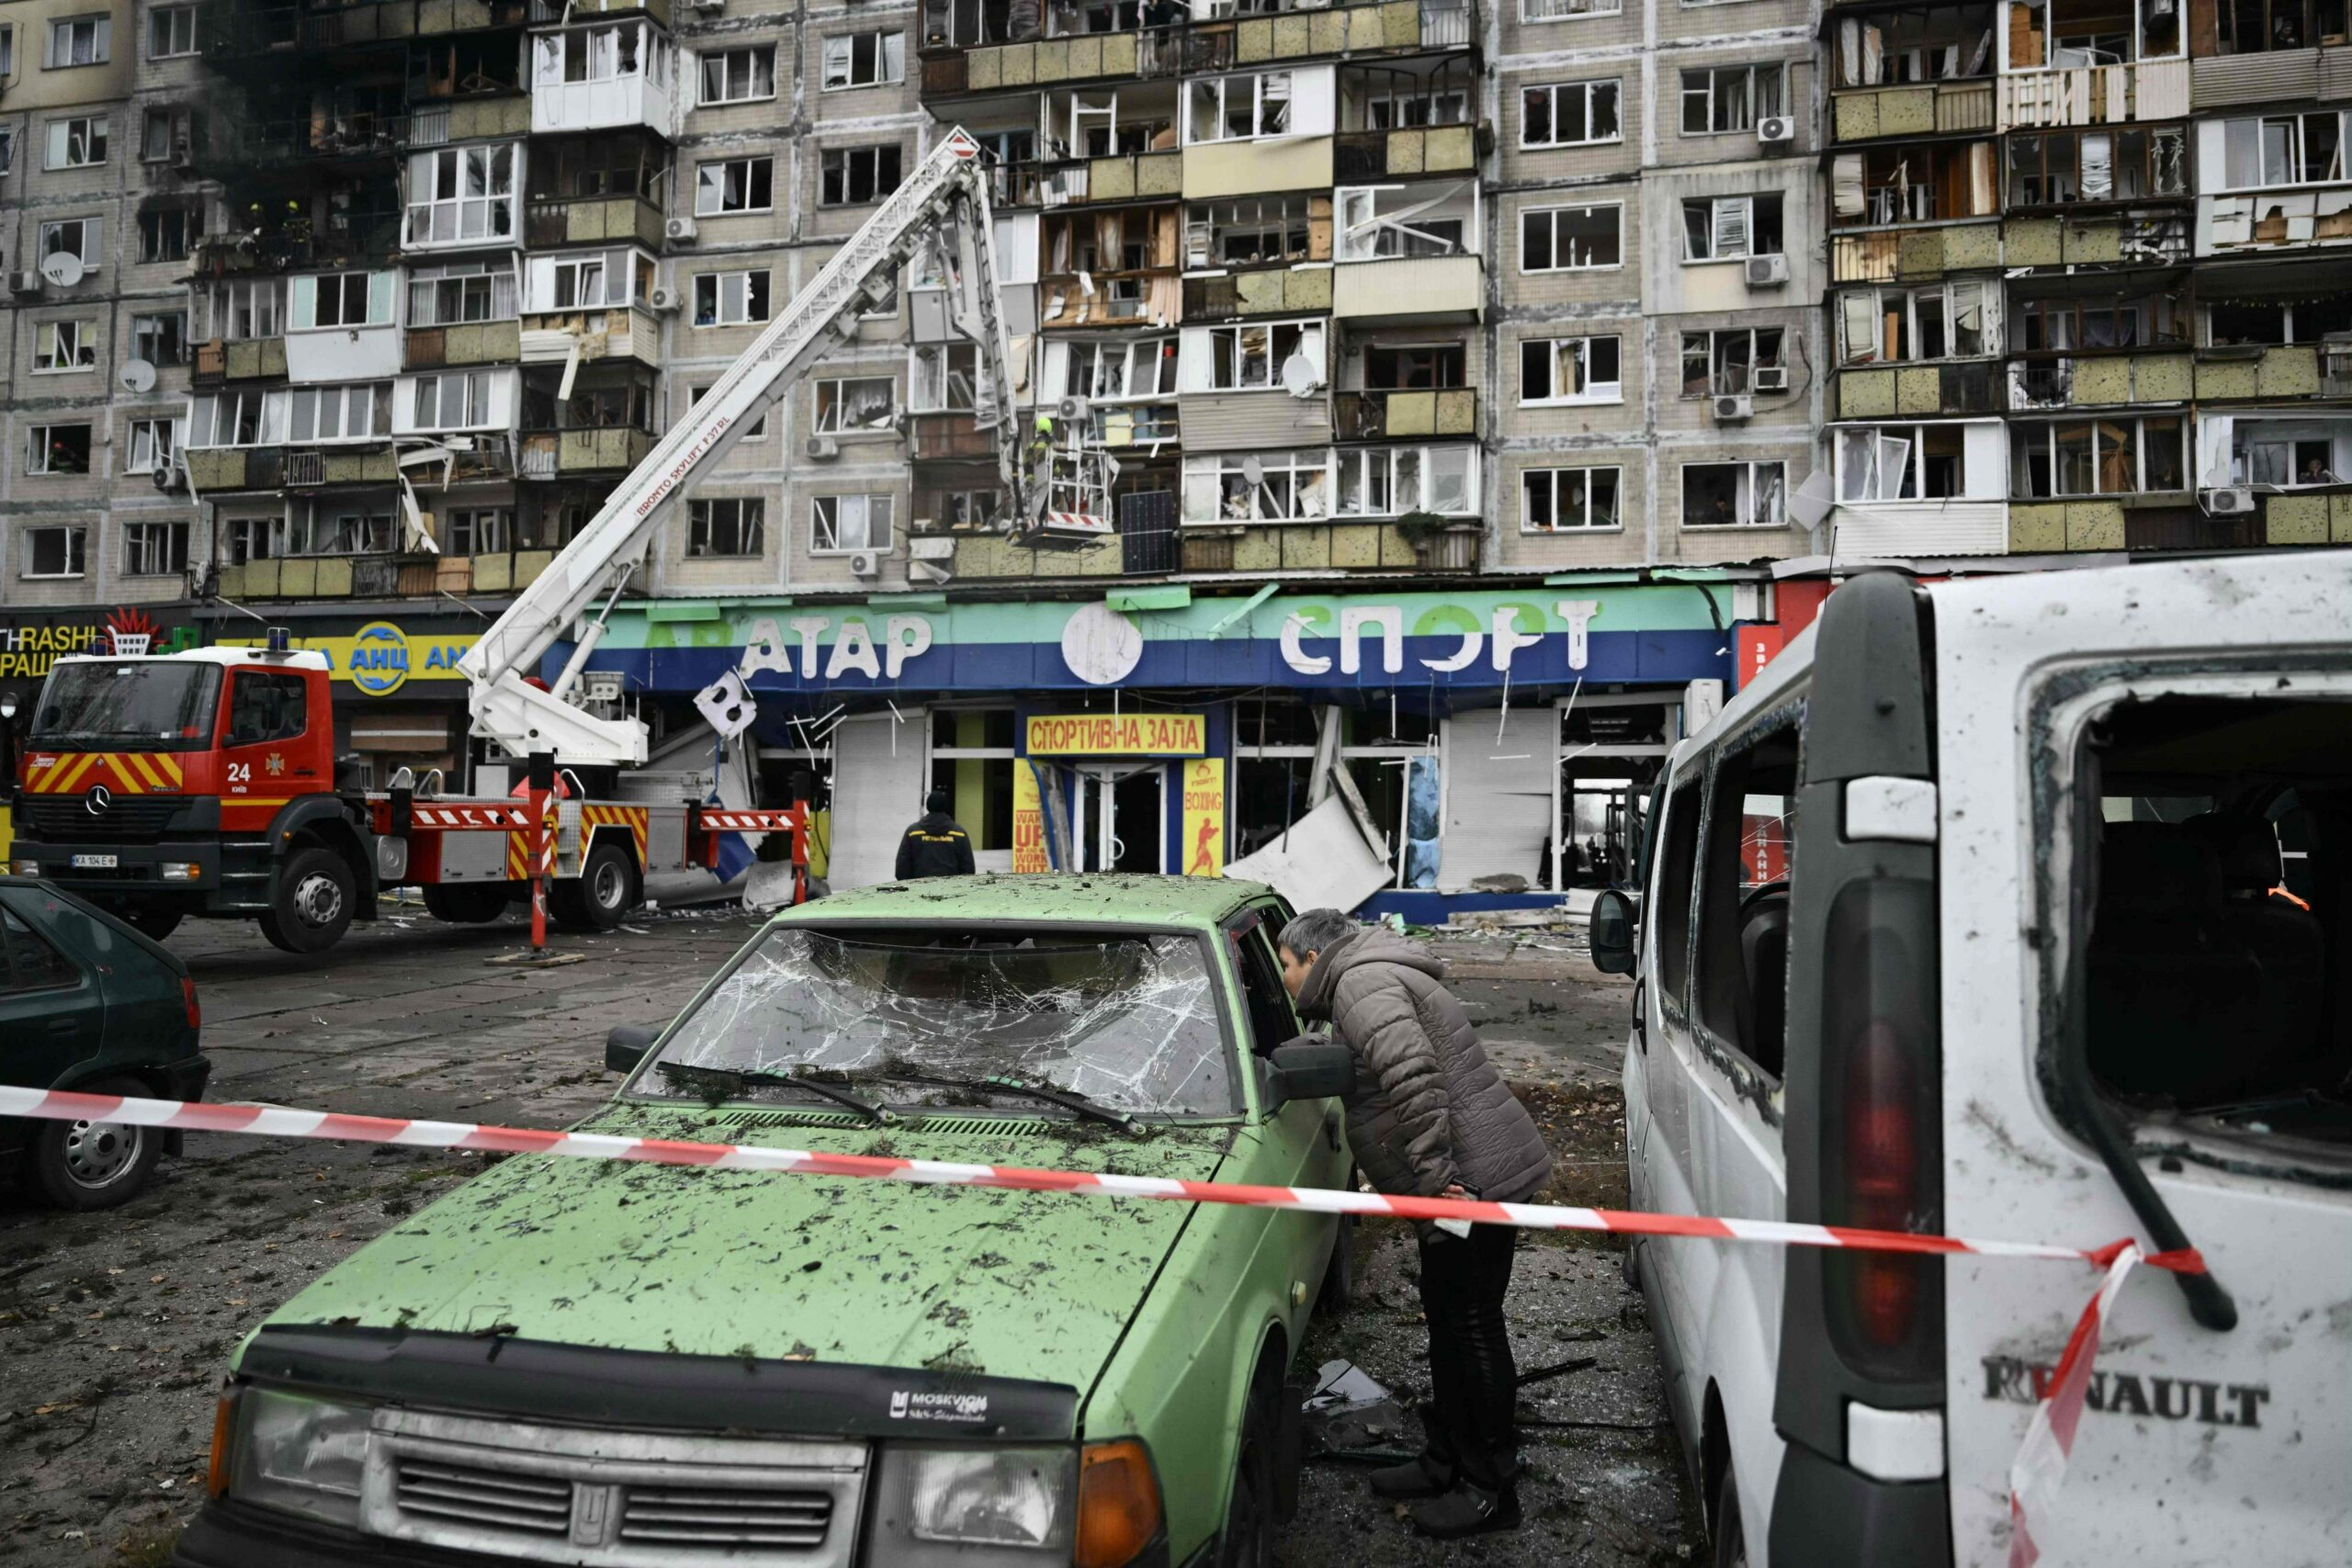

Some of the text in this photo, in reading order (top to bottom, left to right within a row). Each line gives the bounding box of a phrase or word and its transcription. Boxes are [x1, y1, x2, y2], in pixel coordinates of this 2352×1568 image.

[636, 416, 731, 516] BRONTO SKYLIFT F 37 RL
[1279, 600, 1604, 675] СПОРТ
[349, 649, 409, 672] АНЦ
[424, 646, 467, 670] AN
[1031, 718, 1199, 750] СПОРТИВНА ЗАЛА
[227, 762, 251, 783] 24
[1185, 792, 1222, 811] BOXING
[1015, 853, 1047, 863] WORK
